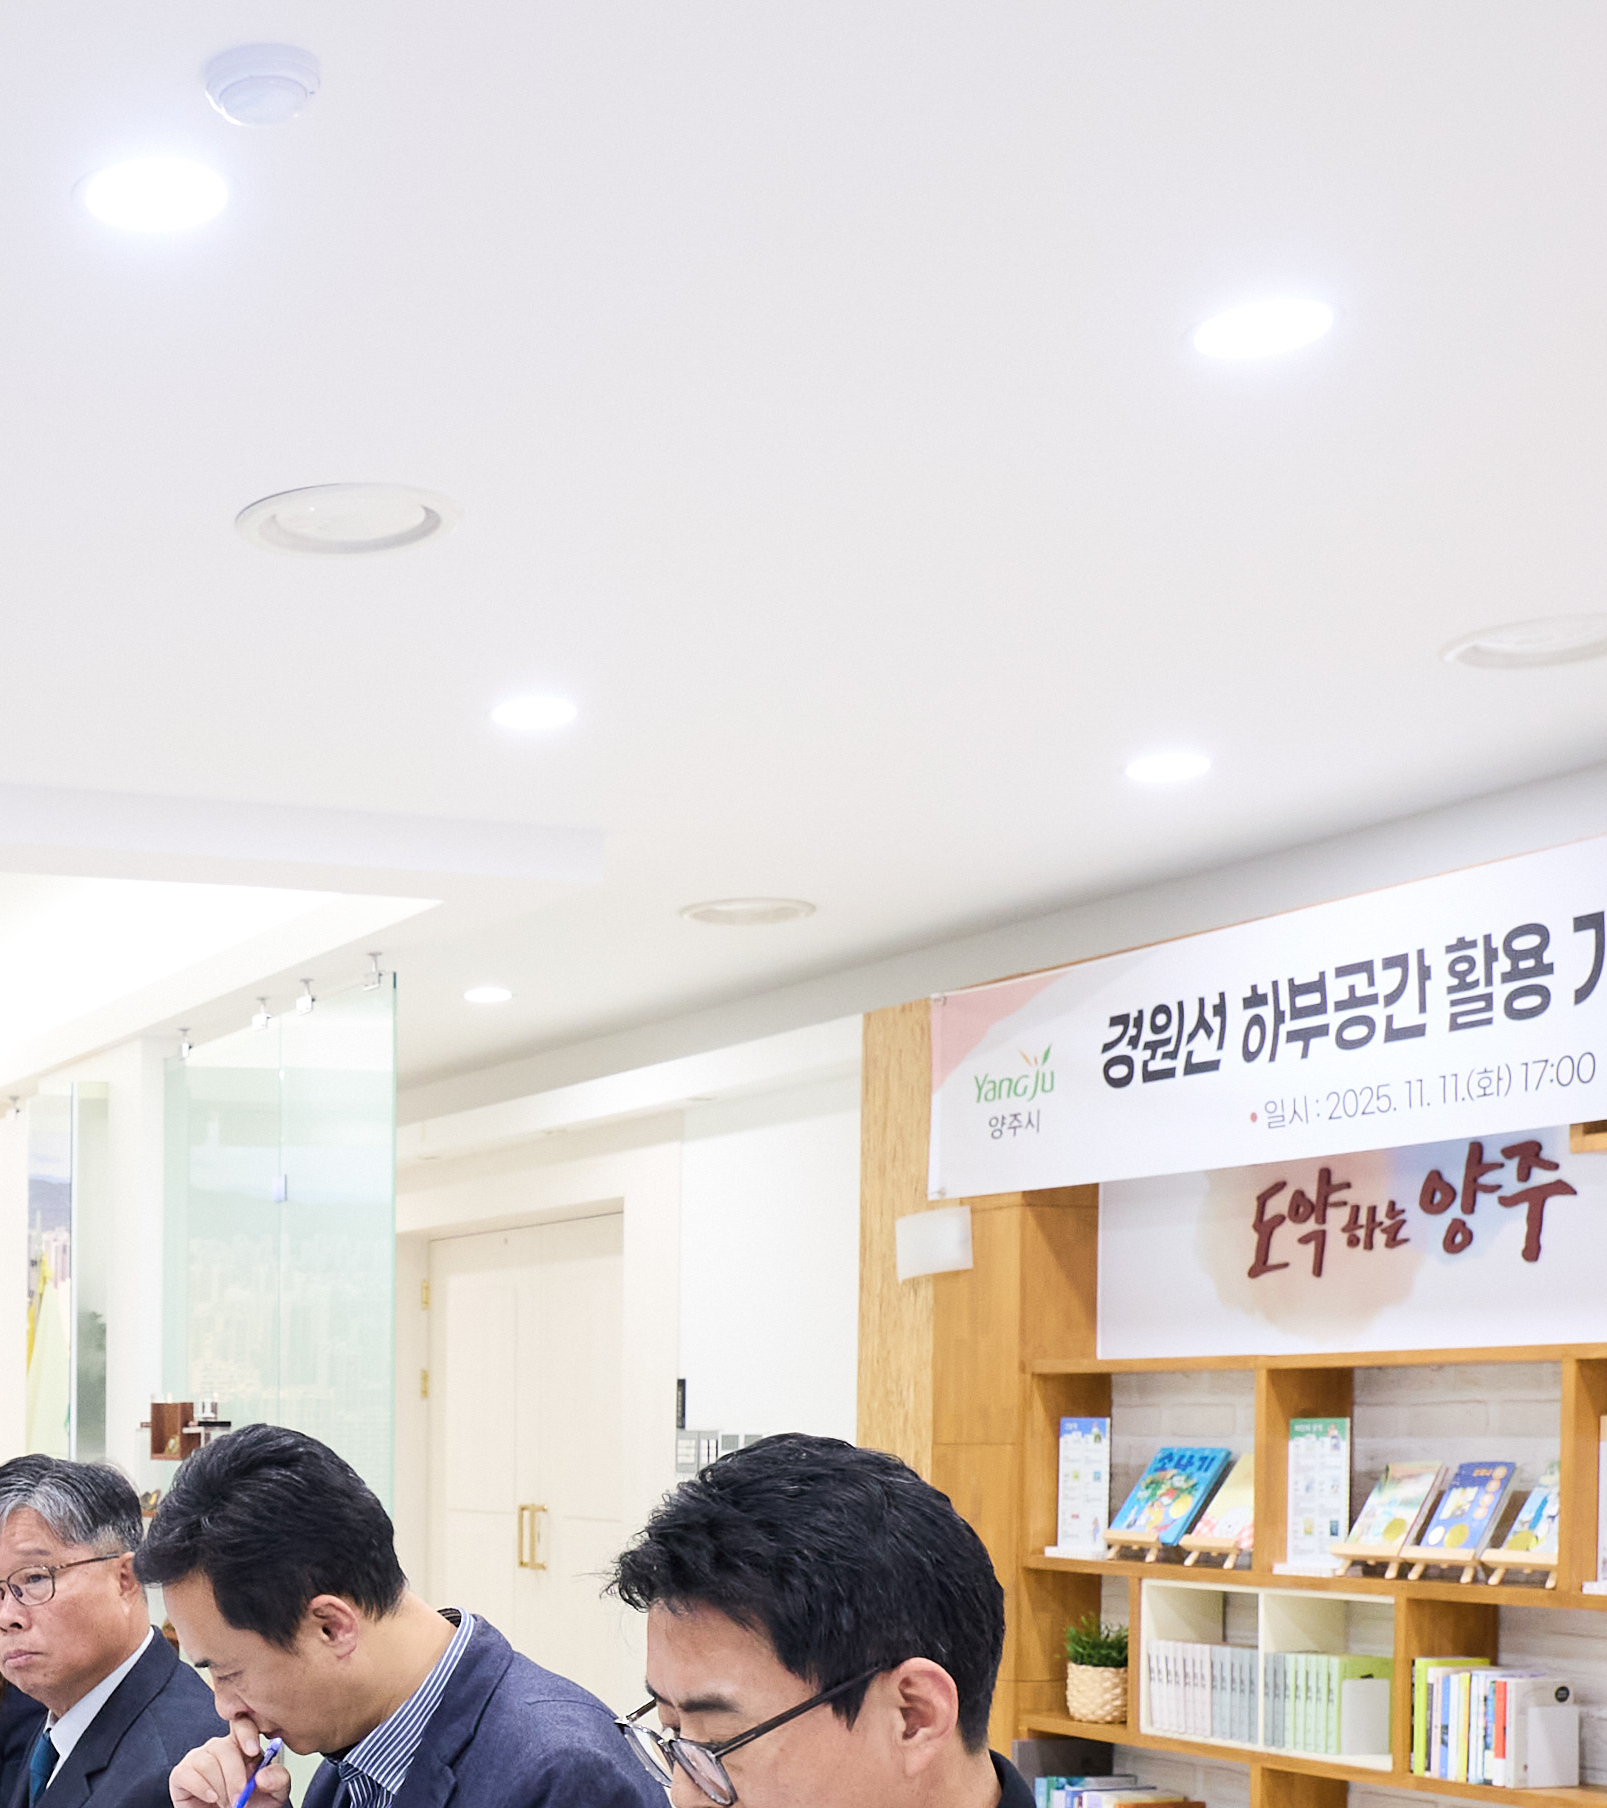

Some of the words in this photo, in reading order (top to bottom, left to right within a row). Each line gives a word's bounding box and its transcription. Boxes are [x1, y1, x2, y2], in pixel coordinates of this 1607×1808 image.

[1100, 991, 1227, 1089] 경원선
[1240, 946, 1433, 1064] 하부공간
[1443, 923, 1555, 1033] 활용
[1325, 1083, 1392, 1122] 2025.
[1405, 1079, 1432, 1110] 11.
[1520, 1050, 1597, 1093] 17:00
[988, 1110, 1041, 1140] 양주시
[1246, 1166, 1410, 1279] 도약하는
[1417, 1139, 1578, 1262] 양주
[1154, 1451, 1216, 1473] 소나기
